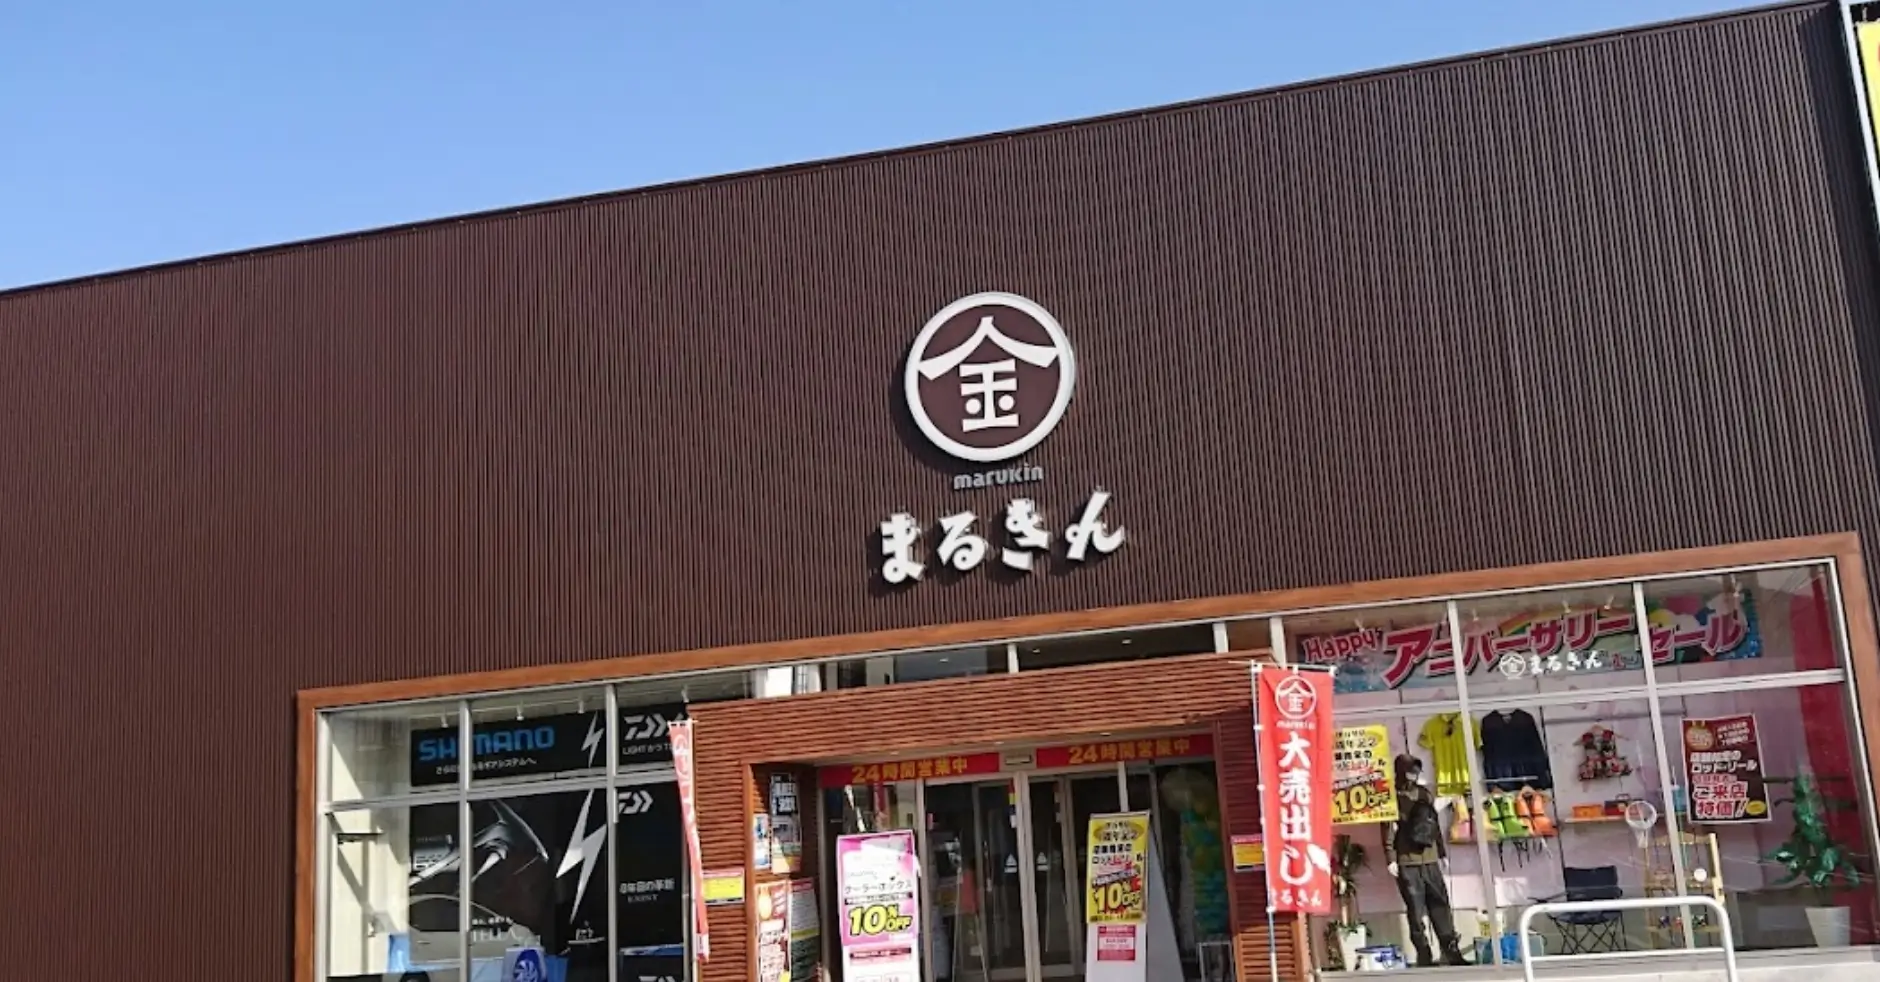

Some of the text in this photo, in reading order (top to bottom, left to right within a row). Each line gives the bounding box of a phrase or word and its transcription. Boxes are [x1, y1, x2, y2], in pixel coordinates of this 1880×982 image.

[917, 315, 1062, 433] 金
[953, 463, 1044, 490] marukin
[880, 491, 1125, 583] まるきん
[1302, 629, 1377, 663] Happy
[1530, 650, 1603, 675] まるきん
[419, 725, 555, 761] SHMANO
[1069, 738, 1190, 765] 24時間営業中
[851, 757, 968, 784] 24時間営業中
[1692, 781, 1748, 800] ご来店
[1278, 731, 1314, 886] 大売出し
[885, 914, 913, 933] OFF
